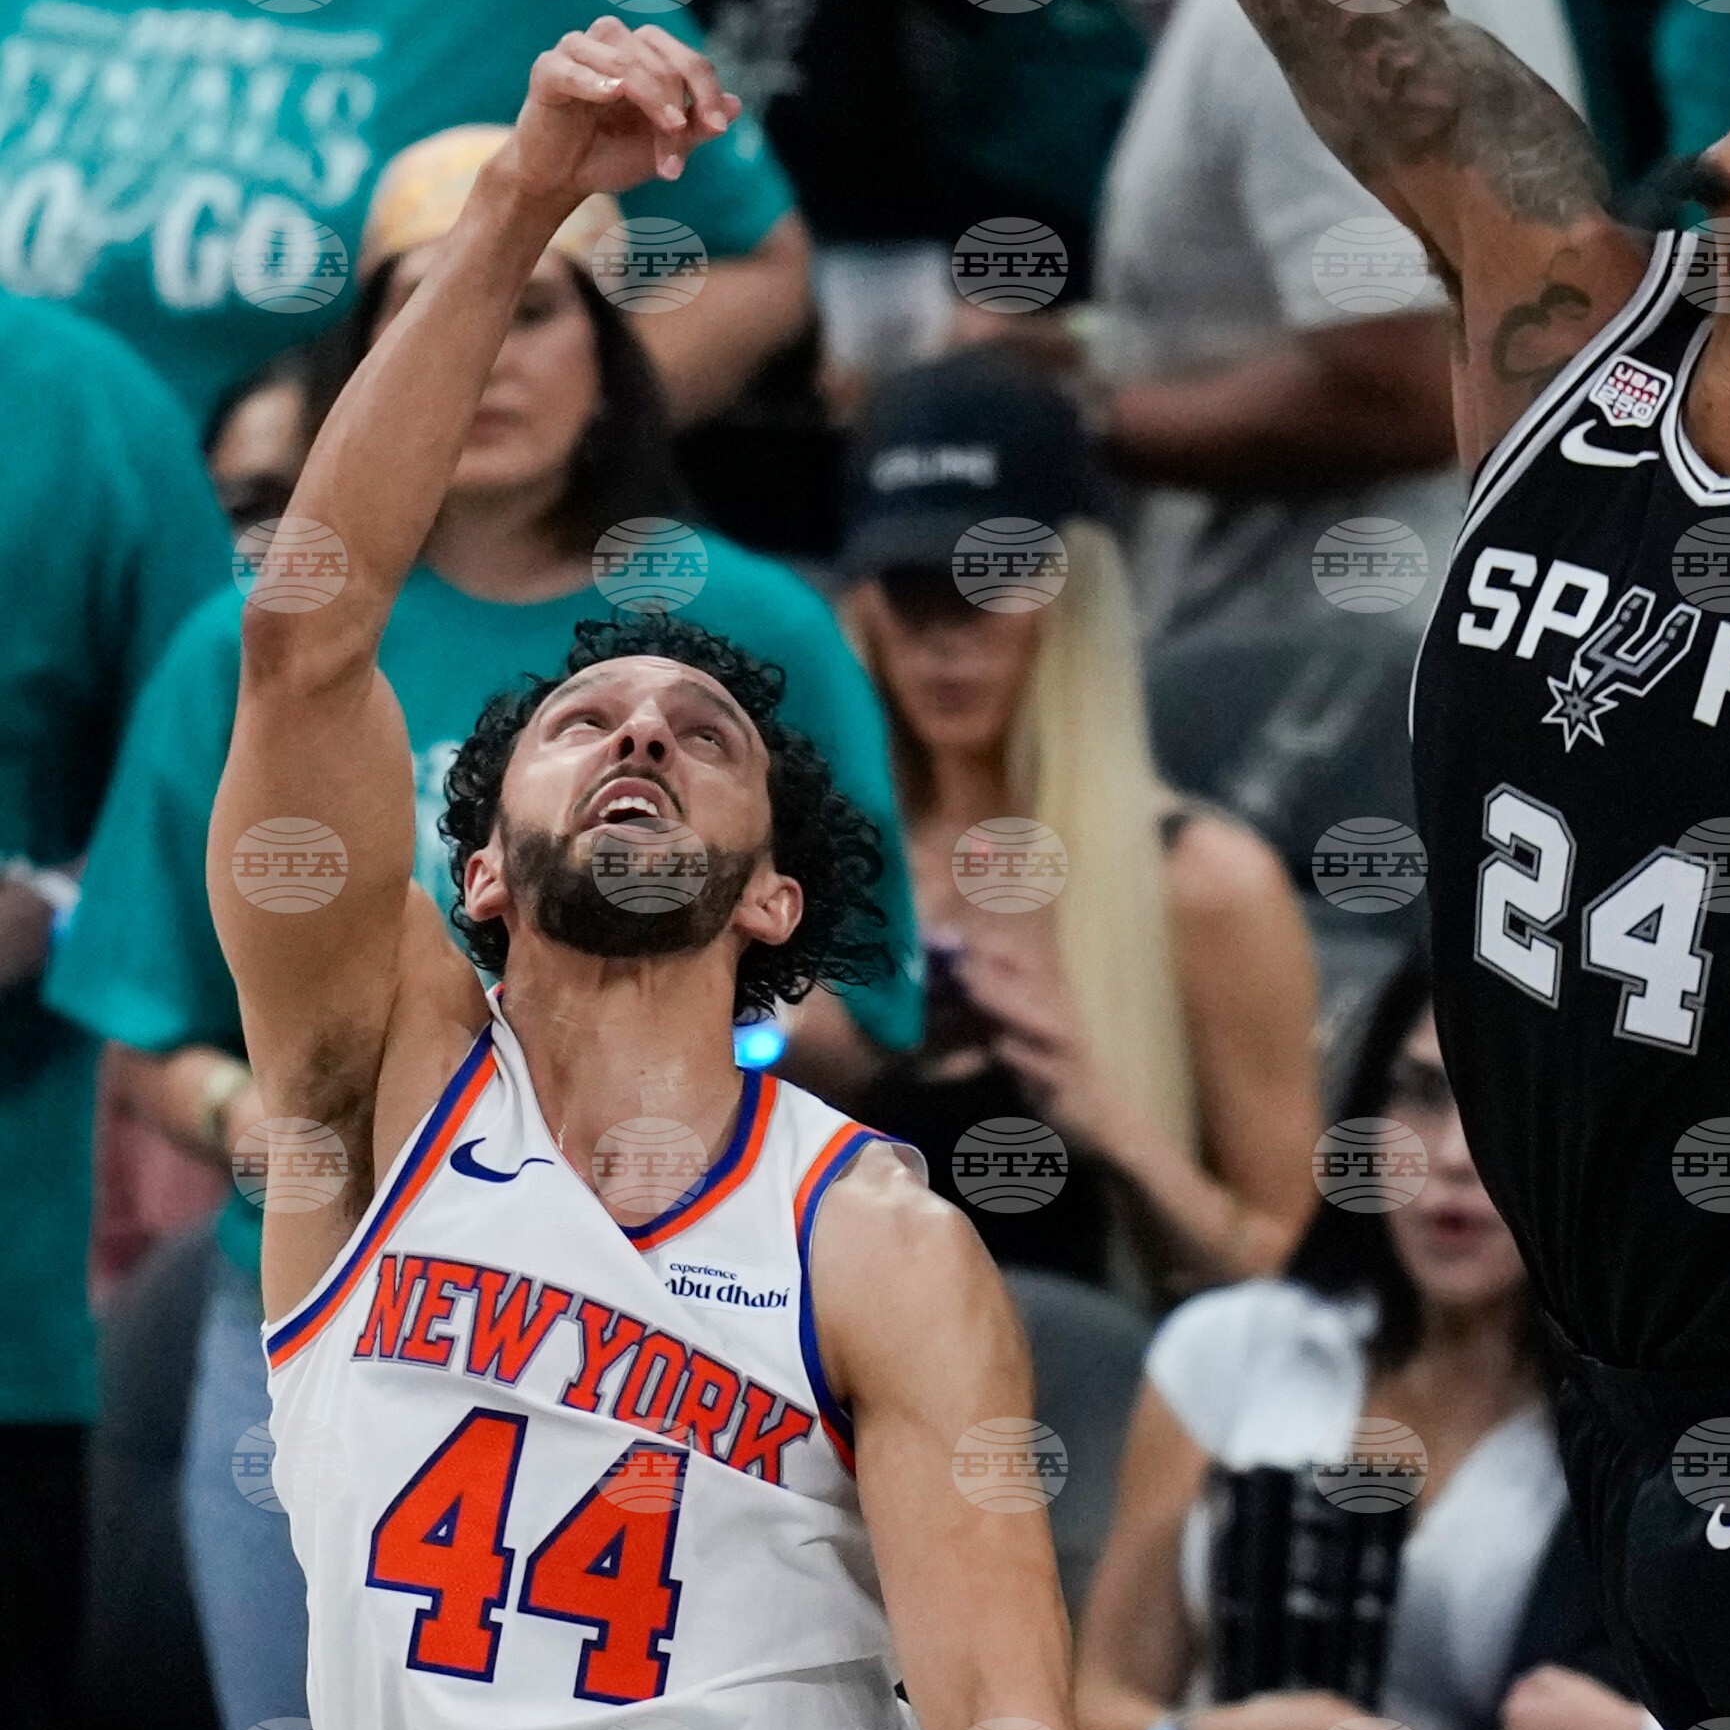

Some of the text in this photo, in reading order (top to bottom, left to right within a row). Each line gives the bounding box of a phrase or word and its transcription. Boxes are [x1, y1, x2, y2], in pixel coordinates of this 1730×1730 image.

[1614, 363, 1661, 397] USA
[1598, 384, 1653, 420] 250
[1474, 782, 1717, 1056] 24
[669, 1262, 737, 1281] experience
[664, 1275, 790, 1308] abu dhabi
[351, 1251, 818, 1489] NEW YORK
[365, 1406, 691, 1706] 44
